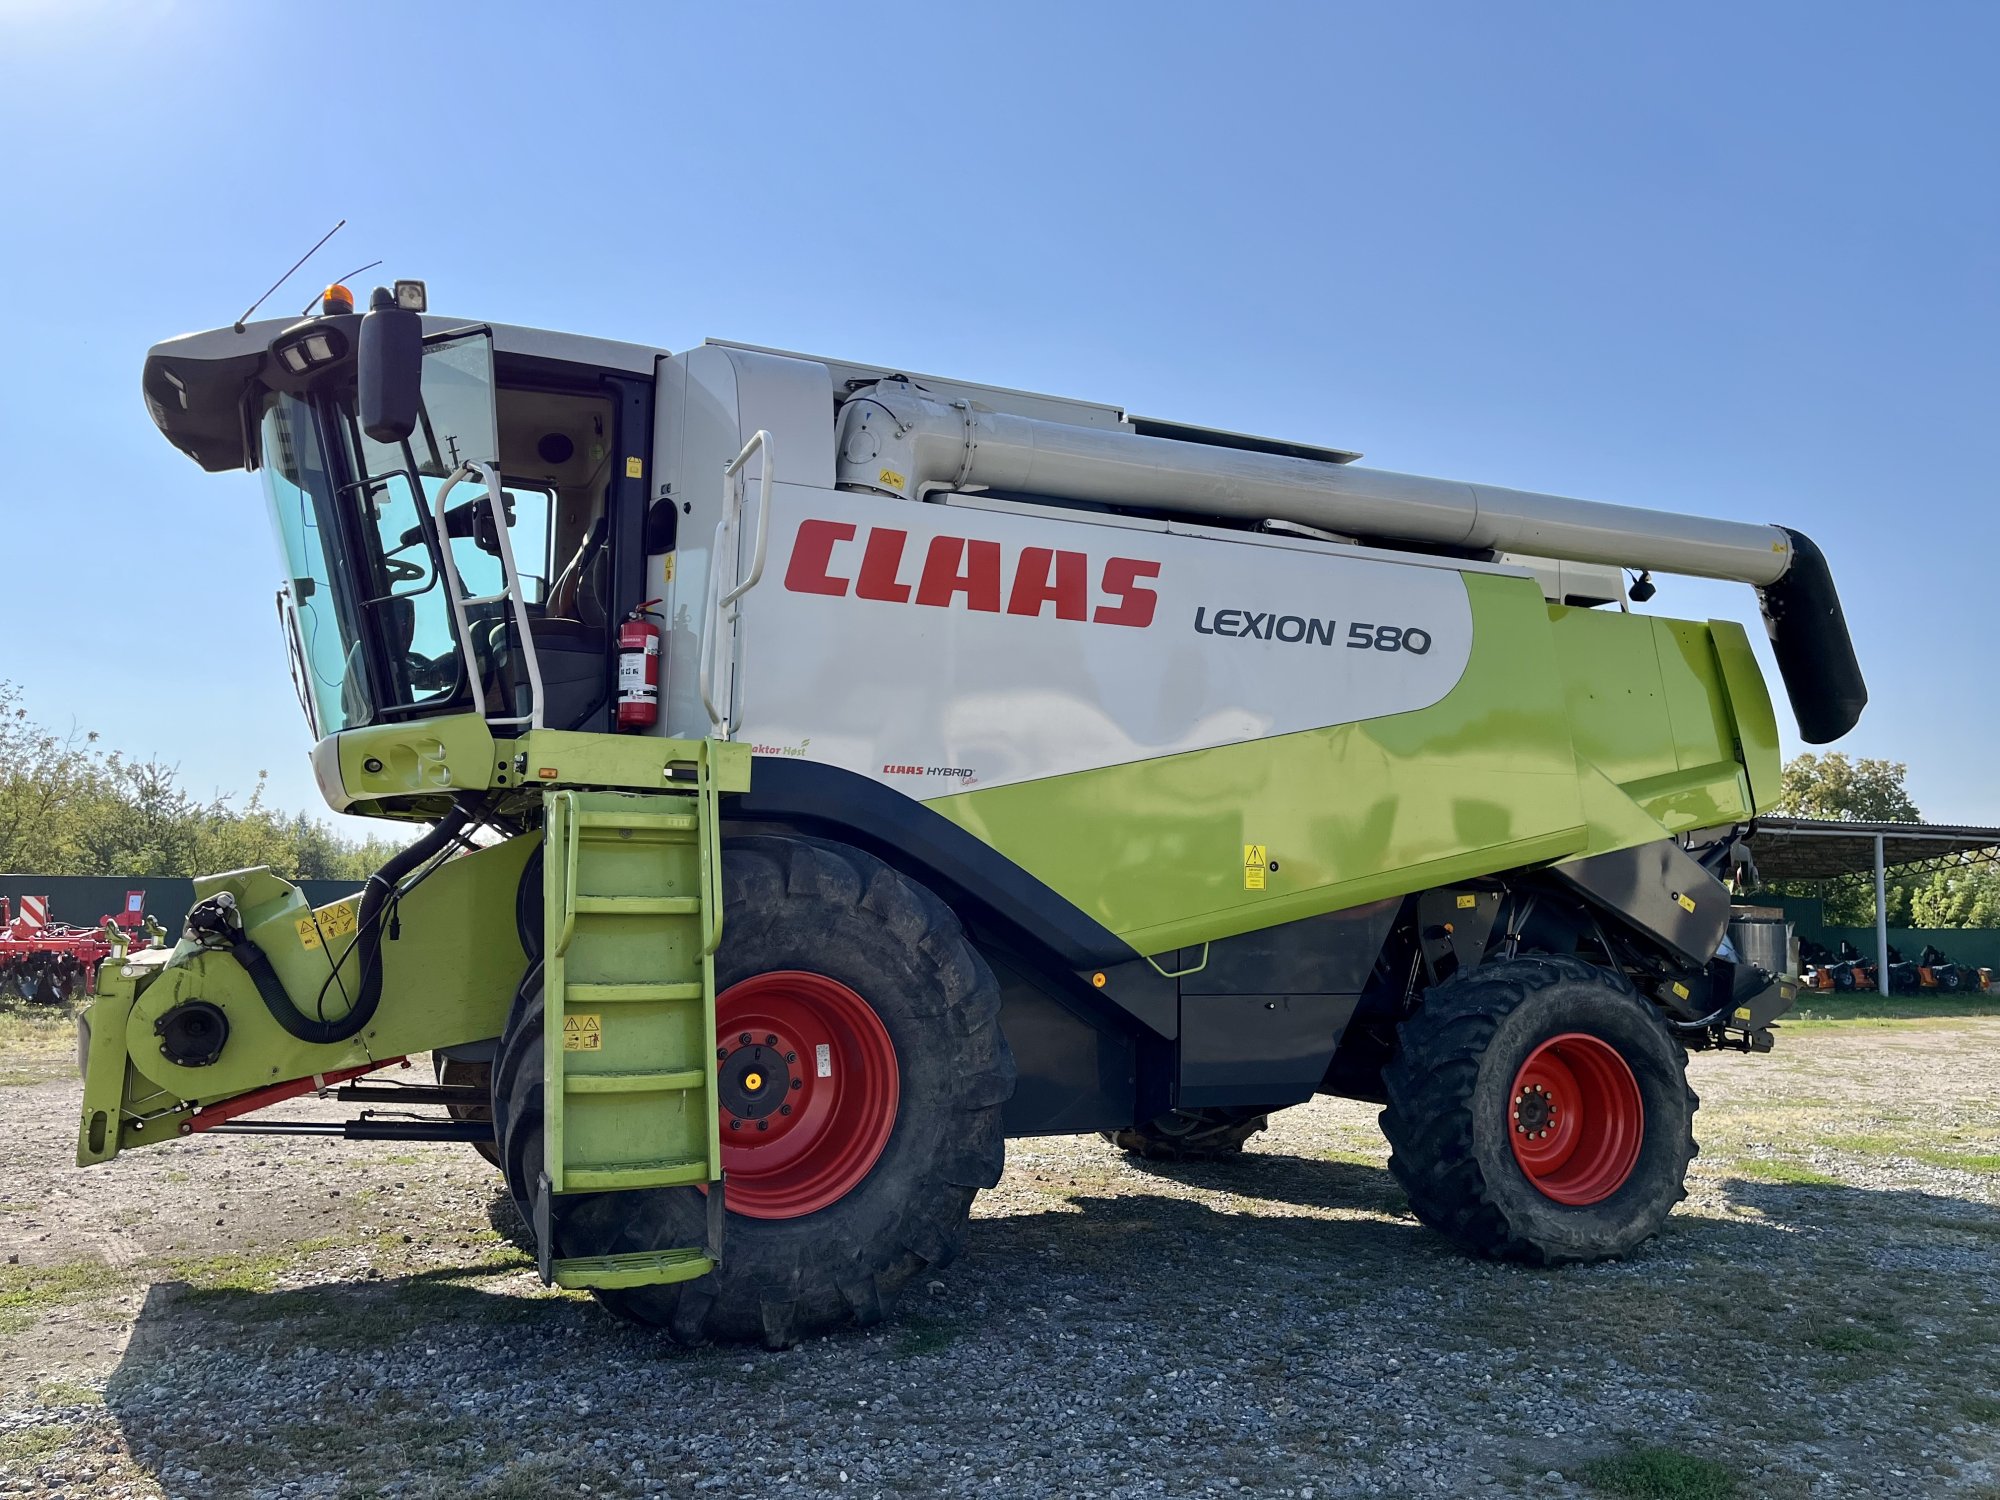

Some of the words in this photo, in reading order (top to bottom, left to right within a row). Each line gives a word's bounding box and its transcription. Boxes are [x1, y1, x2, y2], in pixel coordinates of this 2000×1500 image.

[784, 518, 1162, 628] CLAAS
[1194, 606, 1336, 646] LEXION
[1346, 622, 1432, 655] 580
[752, 744, 781, 754] aktor
[883, 764, 924, 775] CLAAS
[926, 766, 973, 777] HYBRID
